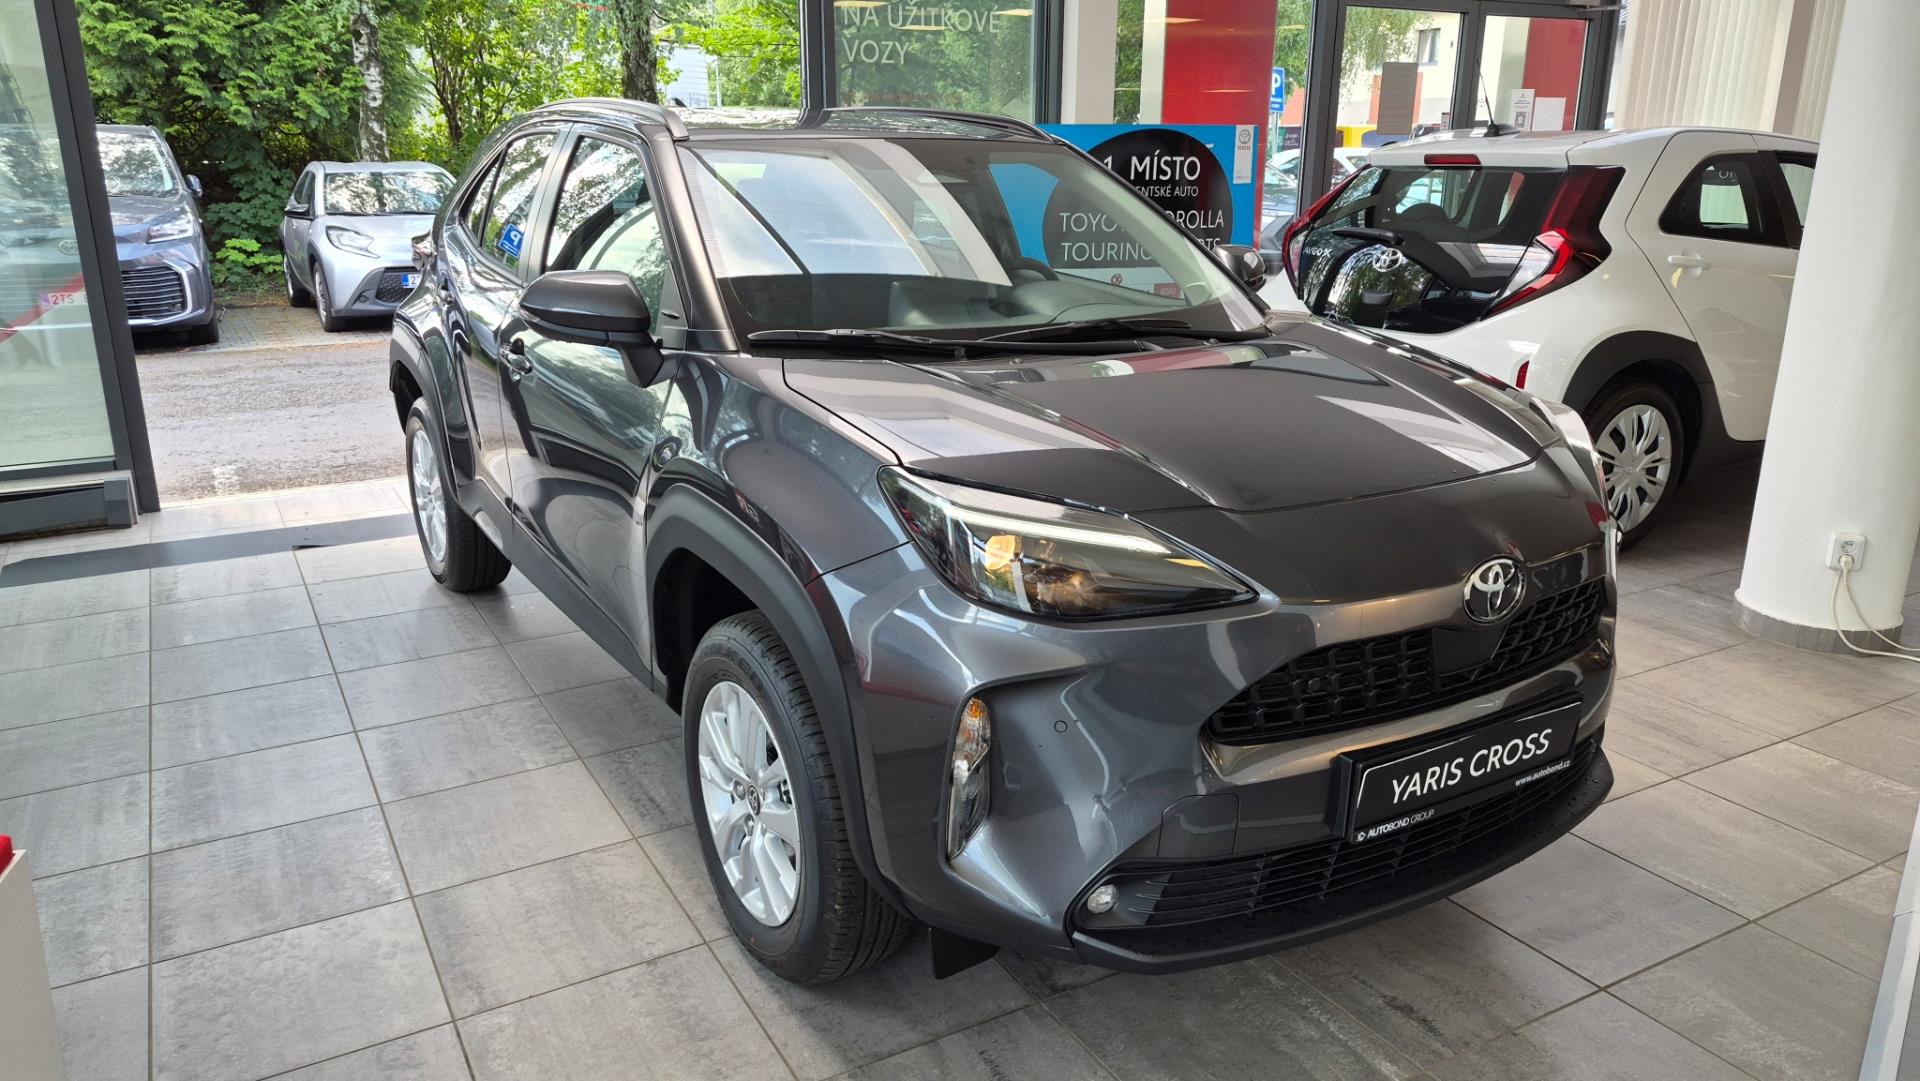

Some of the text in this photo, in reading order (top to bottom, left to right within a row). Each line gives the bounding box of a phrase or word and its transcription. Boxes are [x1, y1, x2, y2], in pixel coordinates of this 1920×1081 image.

[843, 0, 1001, 33] NA UŽITKOVÉ
[842, 38, 910, 65] VOZY
[1129, 149, 1201, 181] MÍSTO
[1173, 185, 1199, 198] AUTO
[1391, 728, 1553, 805] YARIS CROSS
[1514, 759, 1572, 787] www.autobond.cz
[1367, 808, 1435, 839] AUTOBOND GROUP
